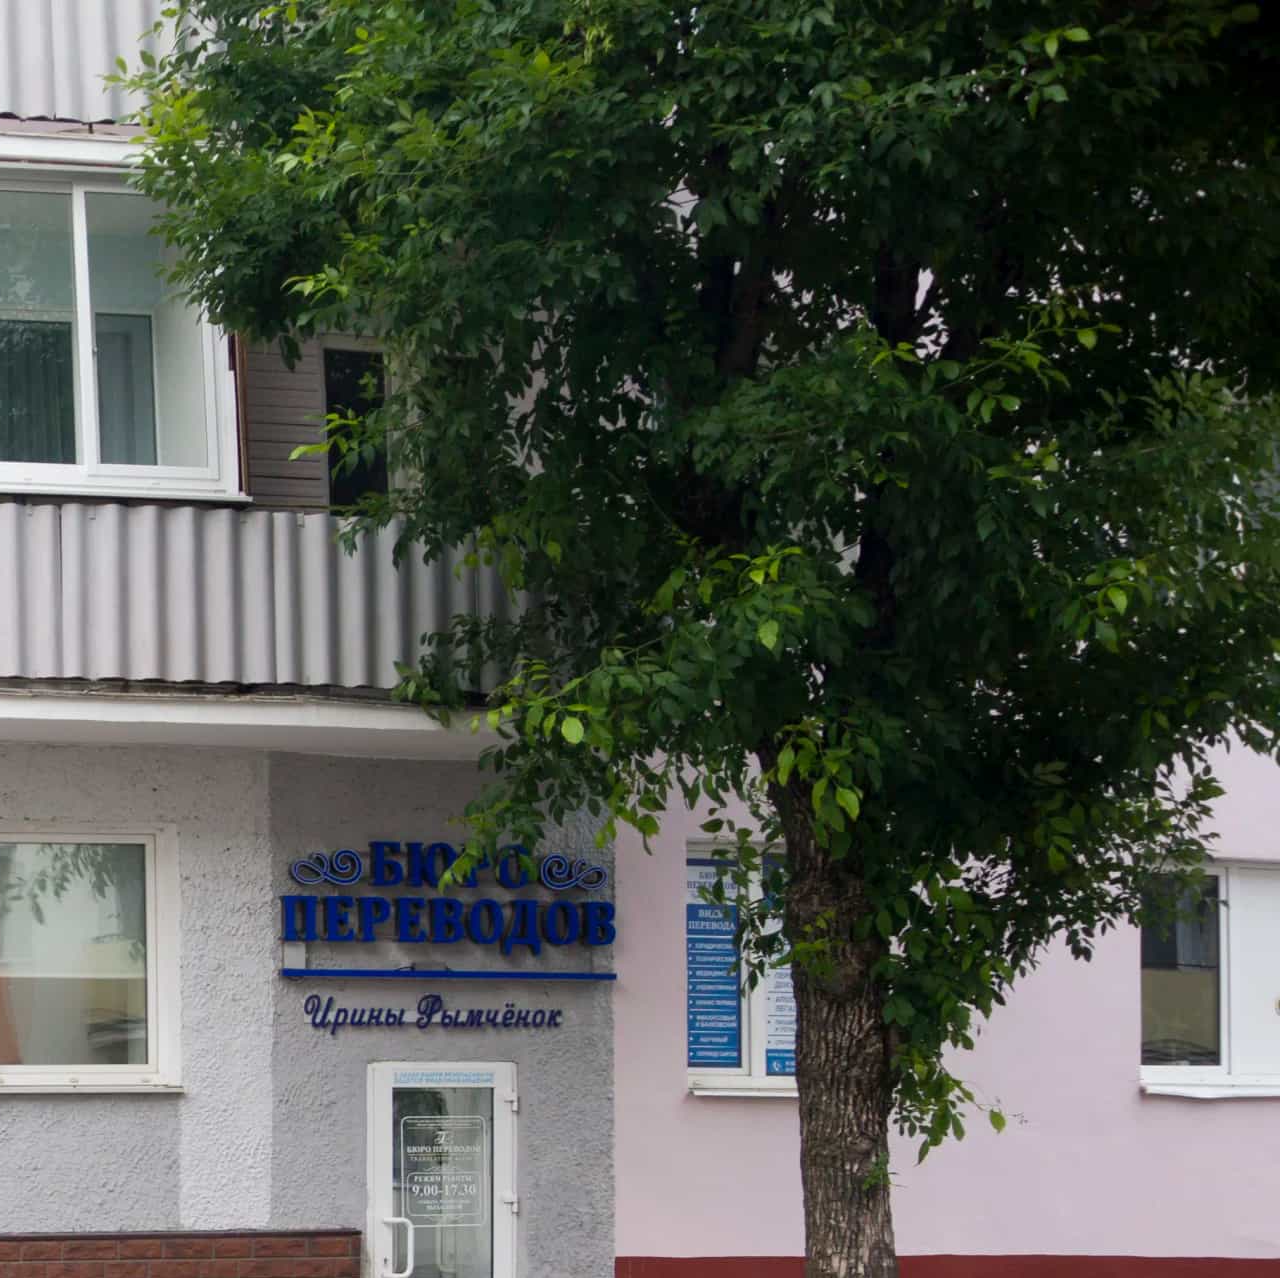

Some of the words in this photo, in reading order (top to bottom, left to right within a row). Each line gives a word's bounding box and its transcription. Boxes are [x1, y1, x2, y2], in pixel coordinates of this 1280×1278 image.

[280, 895, 617, 956] ПЕРЕВОДОВ
[687, 920, 736, 930] ПЕРЕВОДА
[303, 994, 404, 1035] Ирины
[415, 994, 563, 1029] Рымчёнок
[406, 1145, 431, 1153] БЮРО
[414, 1175, 441, 1183] РЕЖИМ
